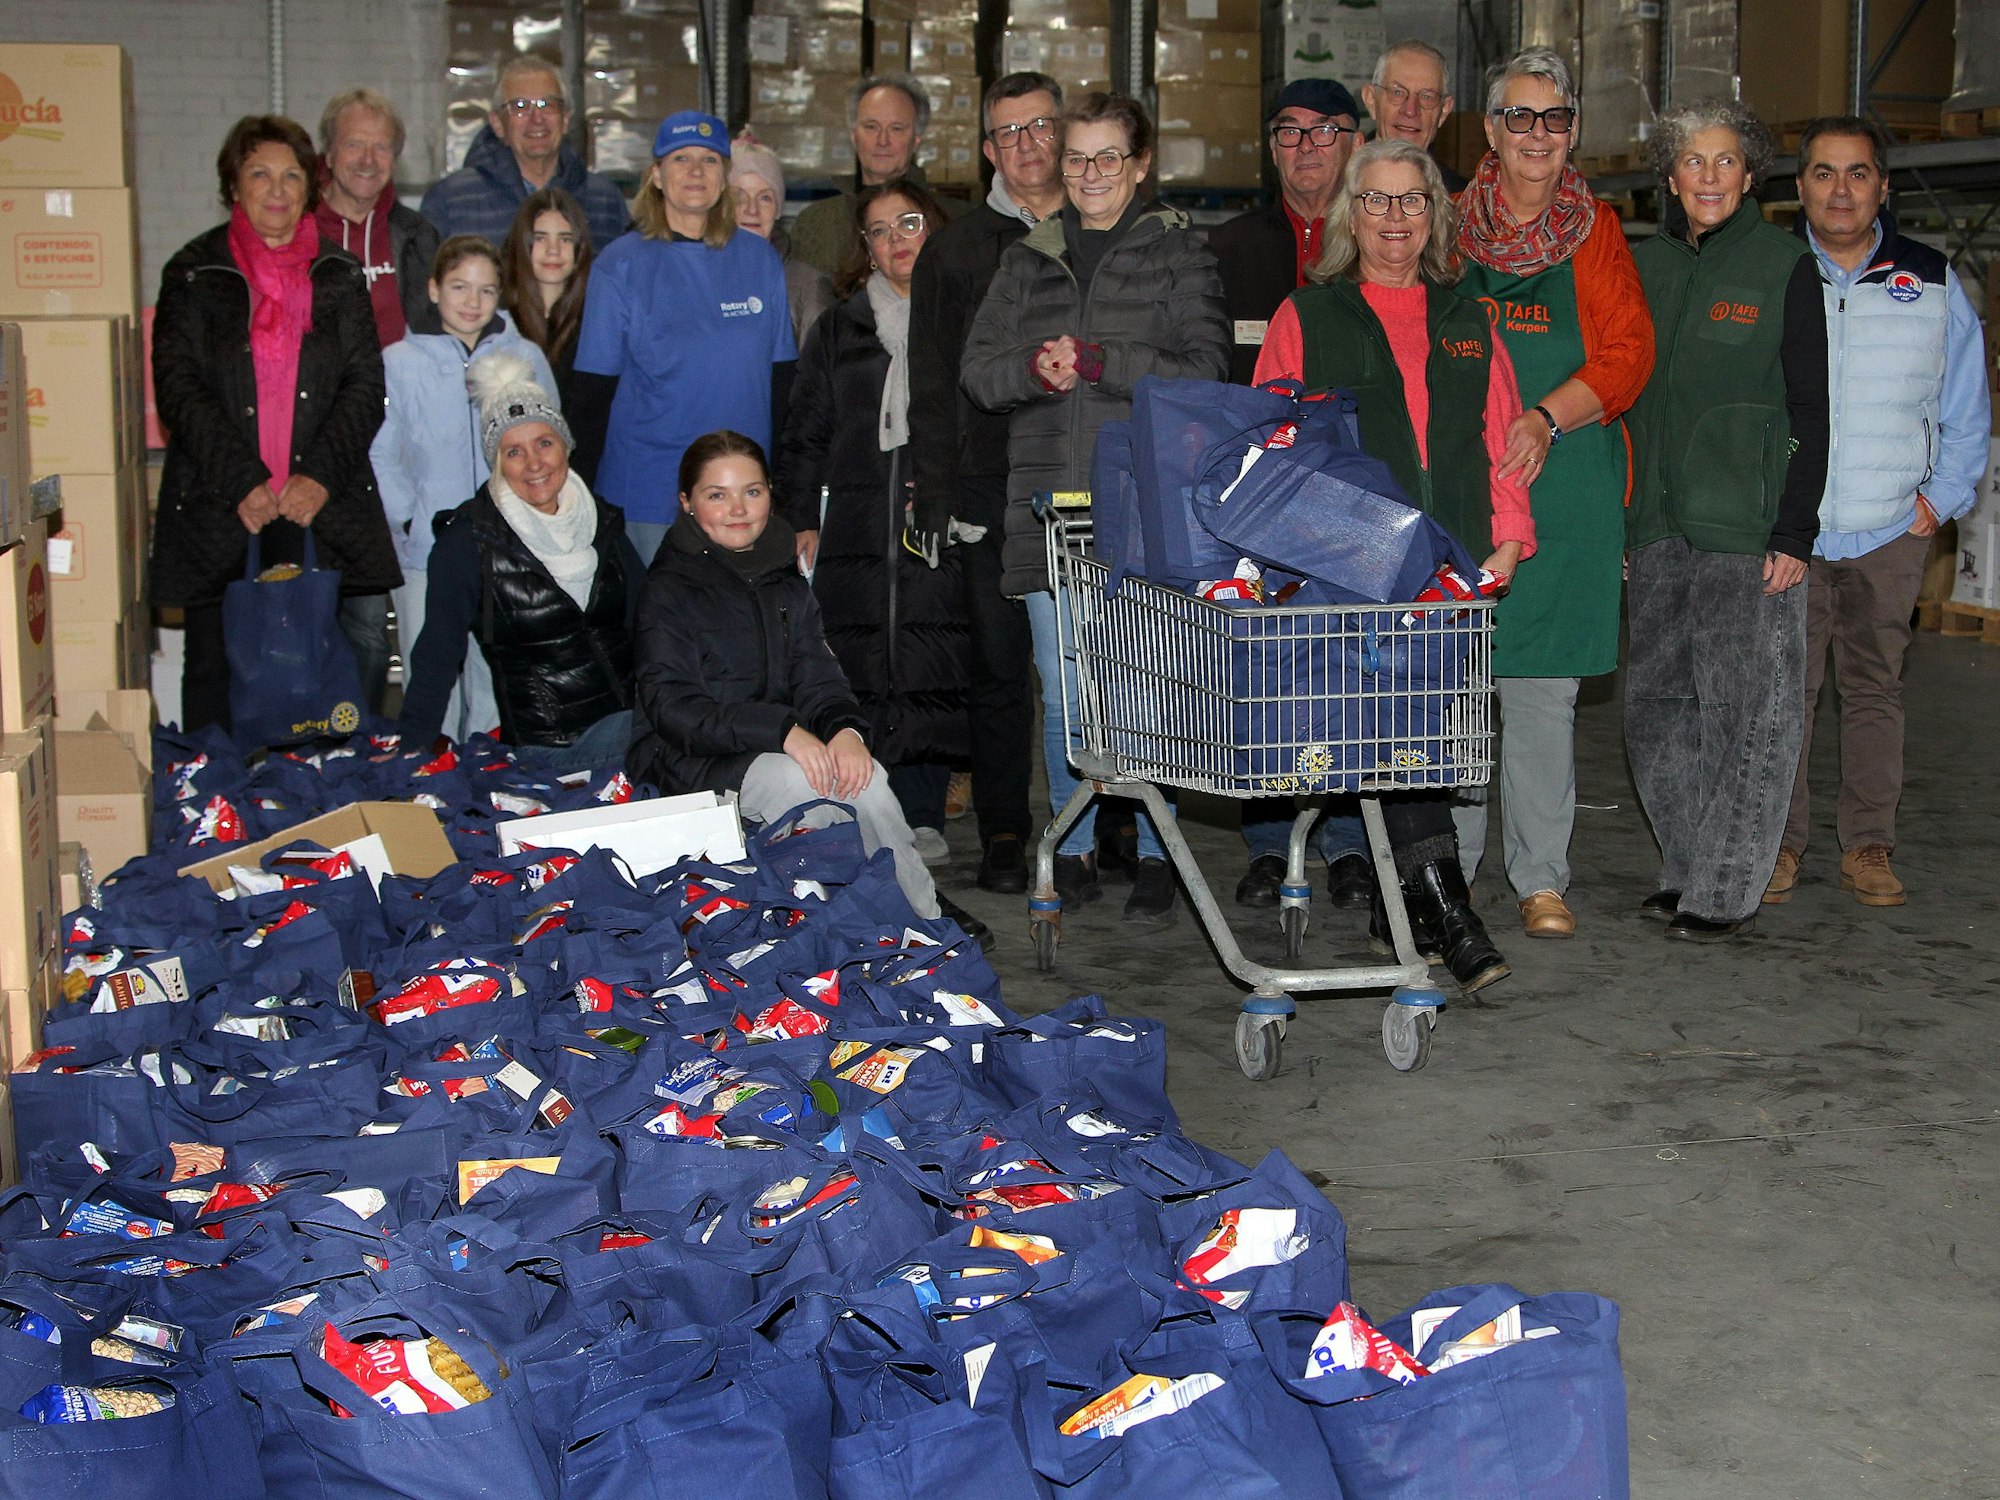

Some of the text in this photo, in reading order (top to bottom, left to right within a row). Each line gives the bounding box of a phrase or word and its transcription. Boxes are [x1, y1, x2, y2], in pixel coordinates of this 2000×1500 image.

[720, 302, 748, 311] Rotary
[1505, 301, 1551, 322] TAFEL
[1732, 303, 1759, 318] TAFEL
[1506, 320, 1549, 334] Kerpen
[1731, 316, 1756, 325] Kerpen
[1455, 340, 1484, 353] TAFEL
[291, 719, 329, 735] Rotary
[1259, 776, 1300, 791] tary
[881, 1065, 899, 1083] ja!
